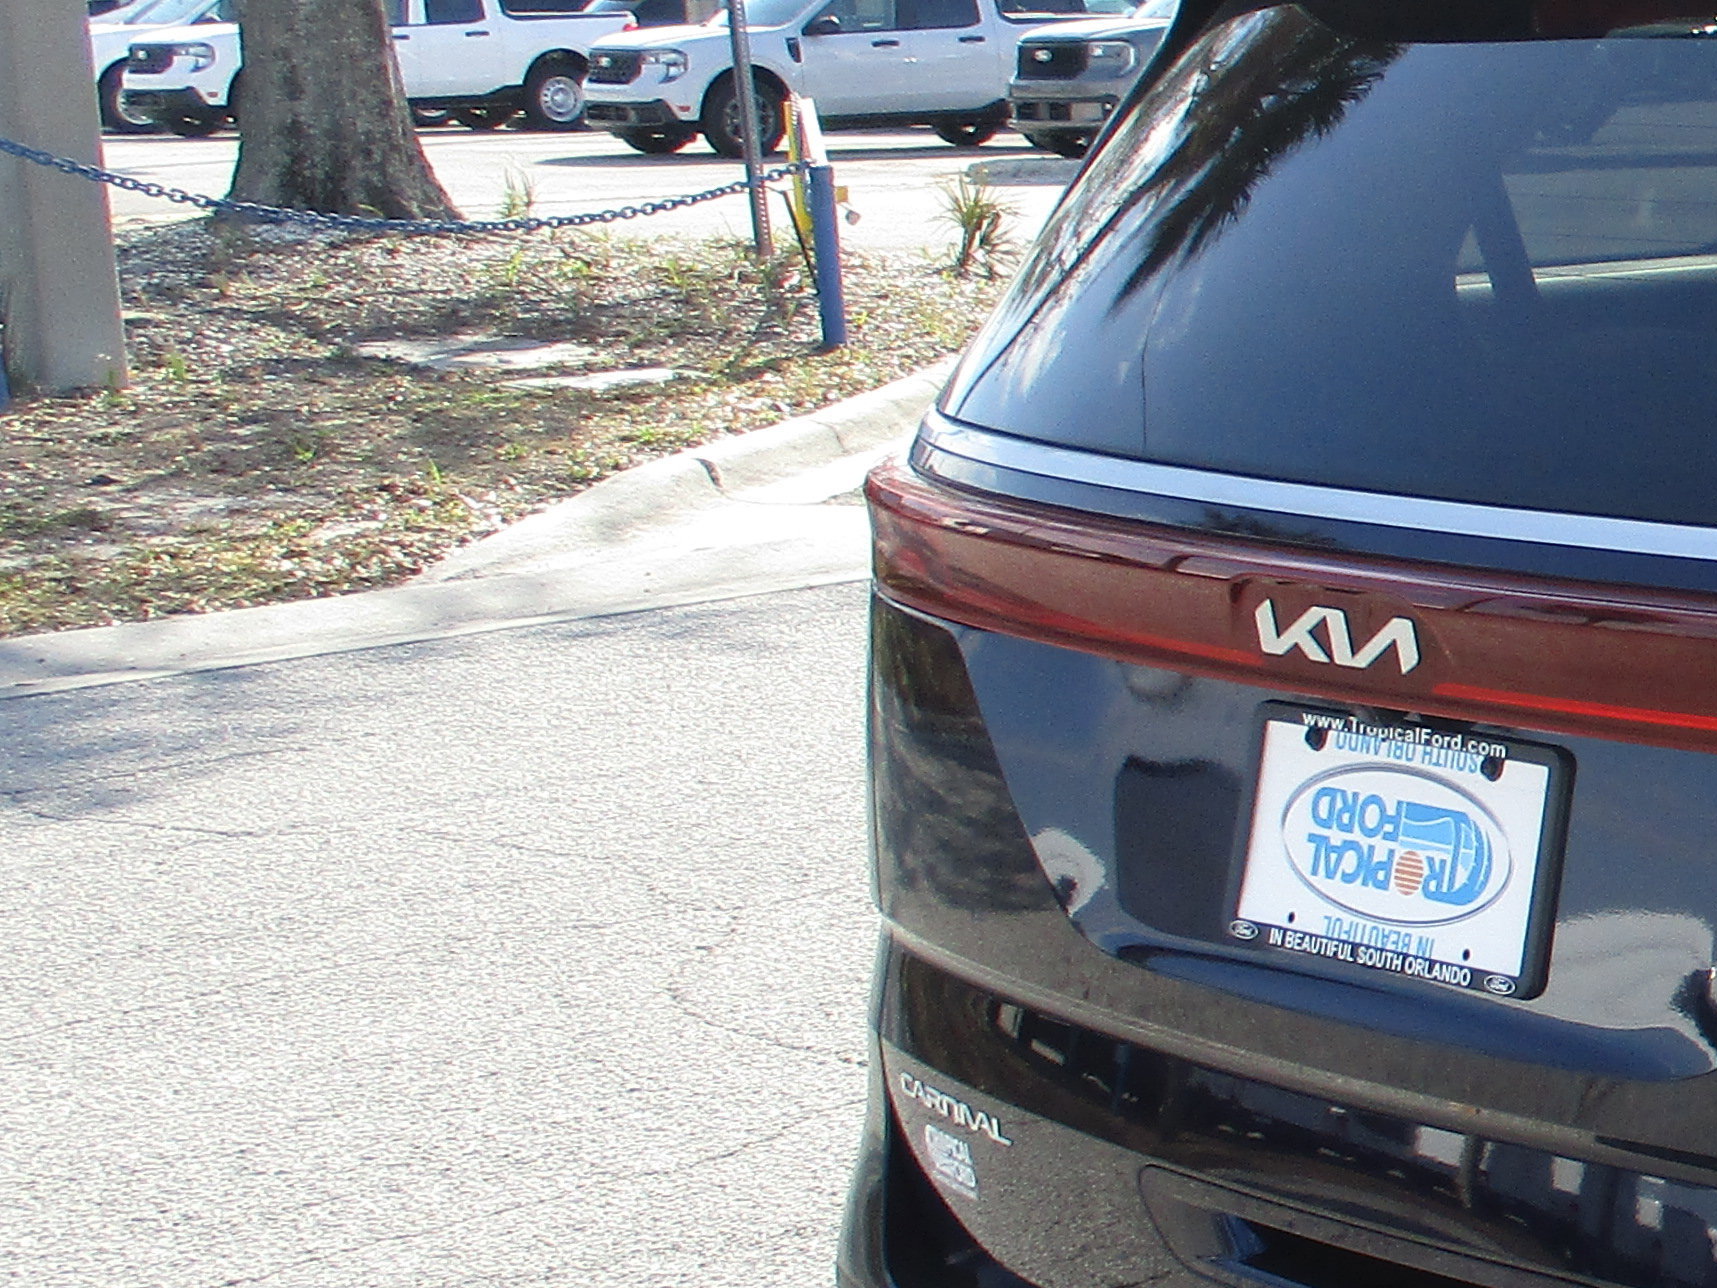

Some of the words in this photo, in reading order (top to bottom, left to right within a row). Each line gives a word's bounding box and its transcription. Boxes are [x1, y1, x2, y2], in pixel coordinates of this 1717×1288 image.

[1254, 597, 1420, 676] KIA
[1302, 711, 1507, 759] www.TropicalFord.com
[1311, 787, 1404, 842] FORD
[1268, 927, 1282, 946] IN
[1285, 929, 1356, 963] BEAUTIFUL
[1356, 944, 1403, 973] SOUTH
[1404, 957, 1472, 987] ORLANDO
